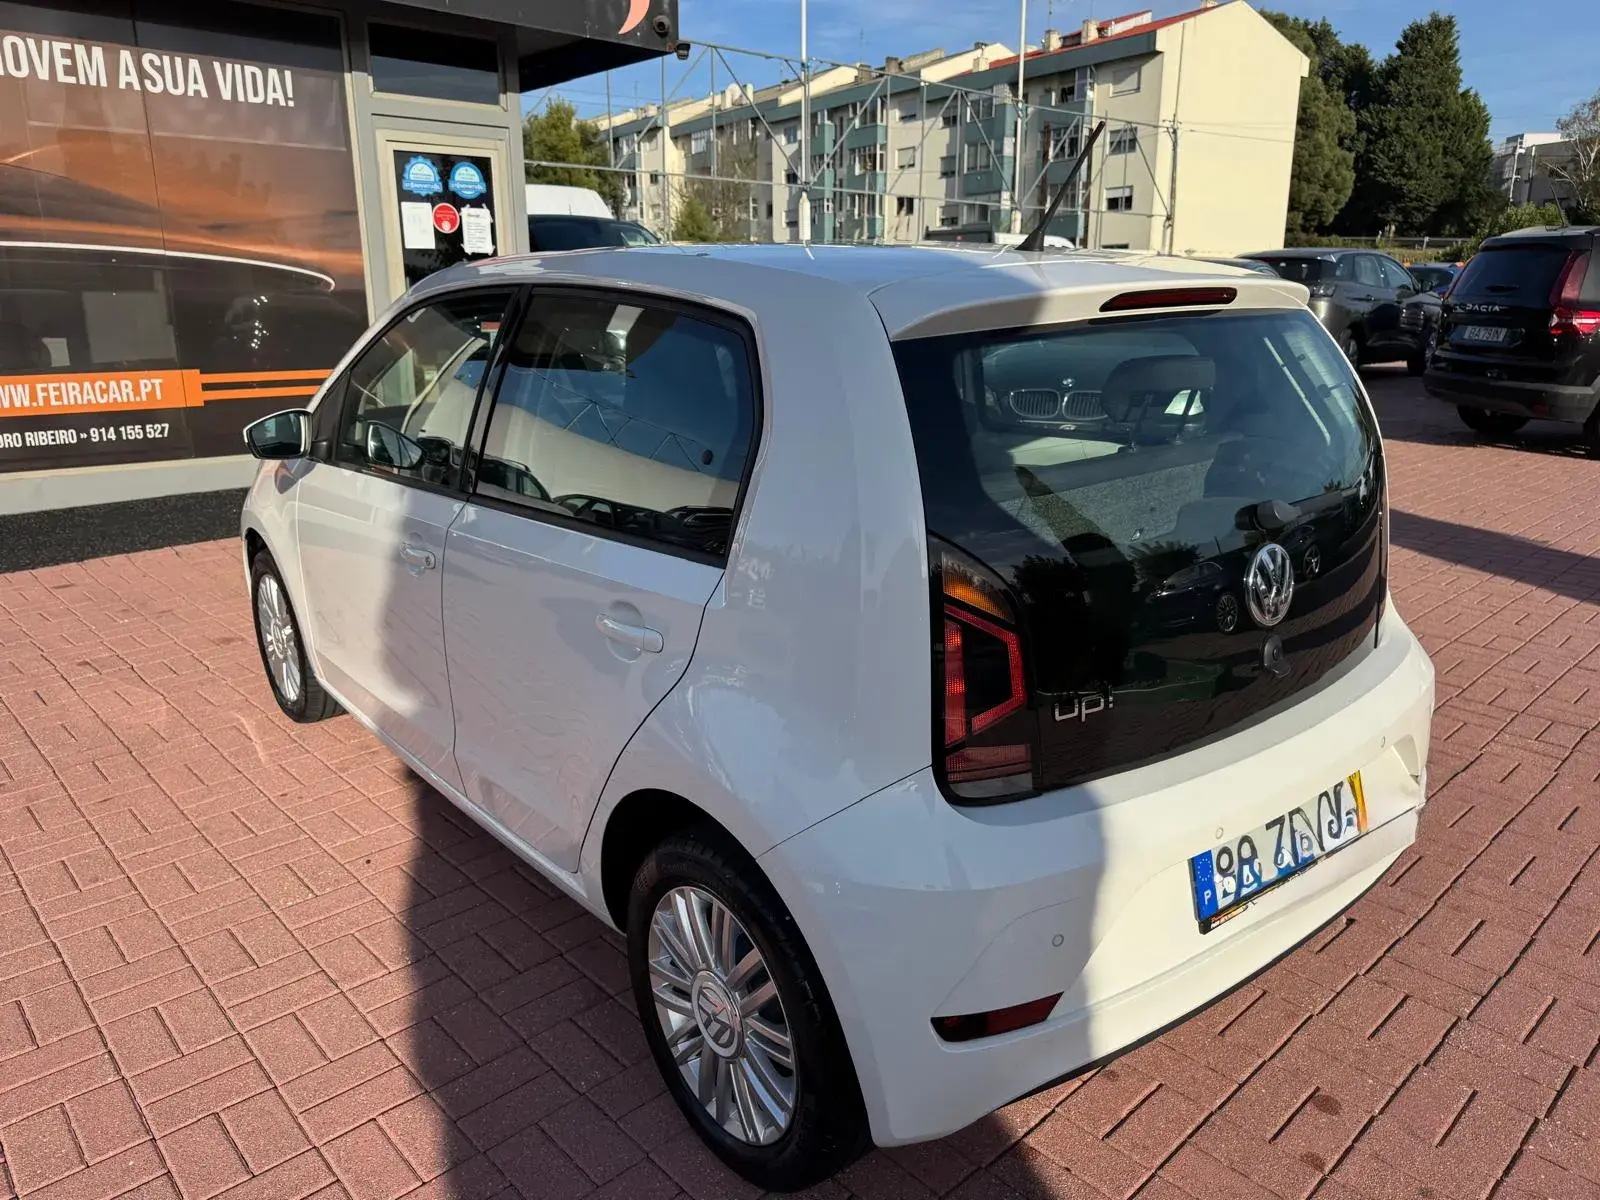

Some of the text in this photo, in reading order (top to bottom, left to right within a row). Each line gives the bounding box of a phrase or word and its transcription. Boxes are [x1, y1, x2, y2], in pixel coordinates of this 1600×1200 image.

[0, 35, 108, 87] OVEM
[212, 61, 295, 107] VIDA!
[1466, 303, 1500, 312] DACIA
[24, 429, 78, 447] RIBEIRO
[90, 427, 117, 442] 914
[119, 425, 144, 440] 155
[146, 423, 169, 438] 527
[1054, 684, 1114, 722] up!
[1203, 889, 1212, 905] P
